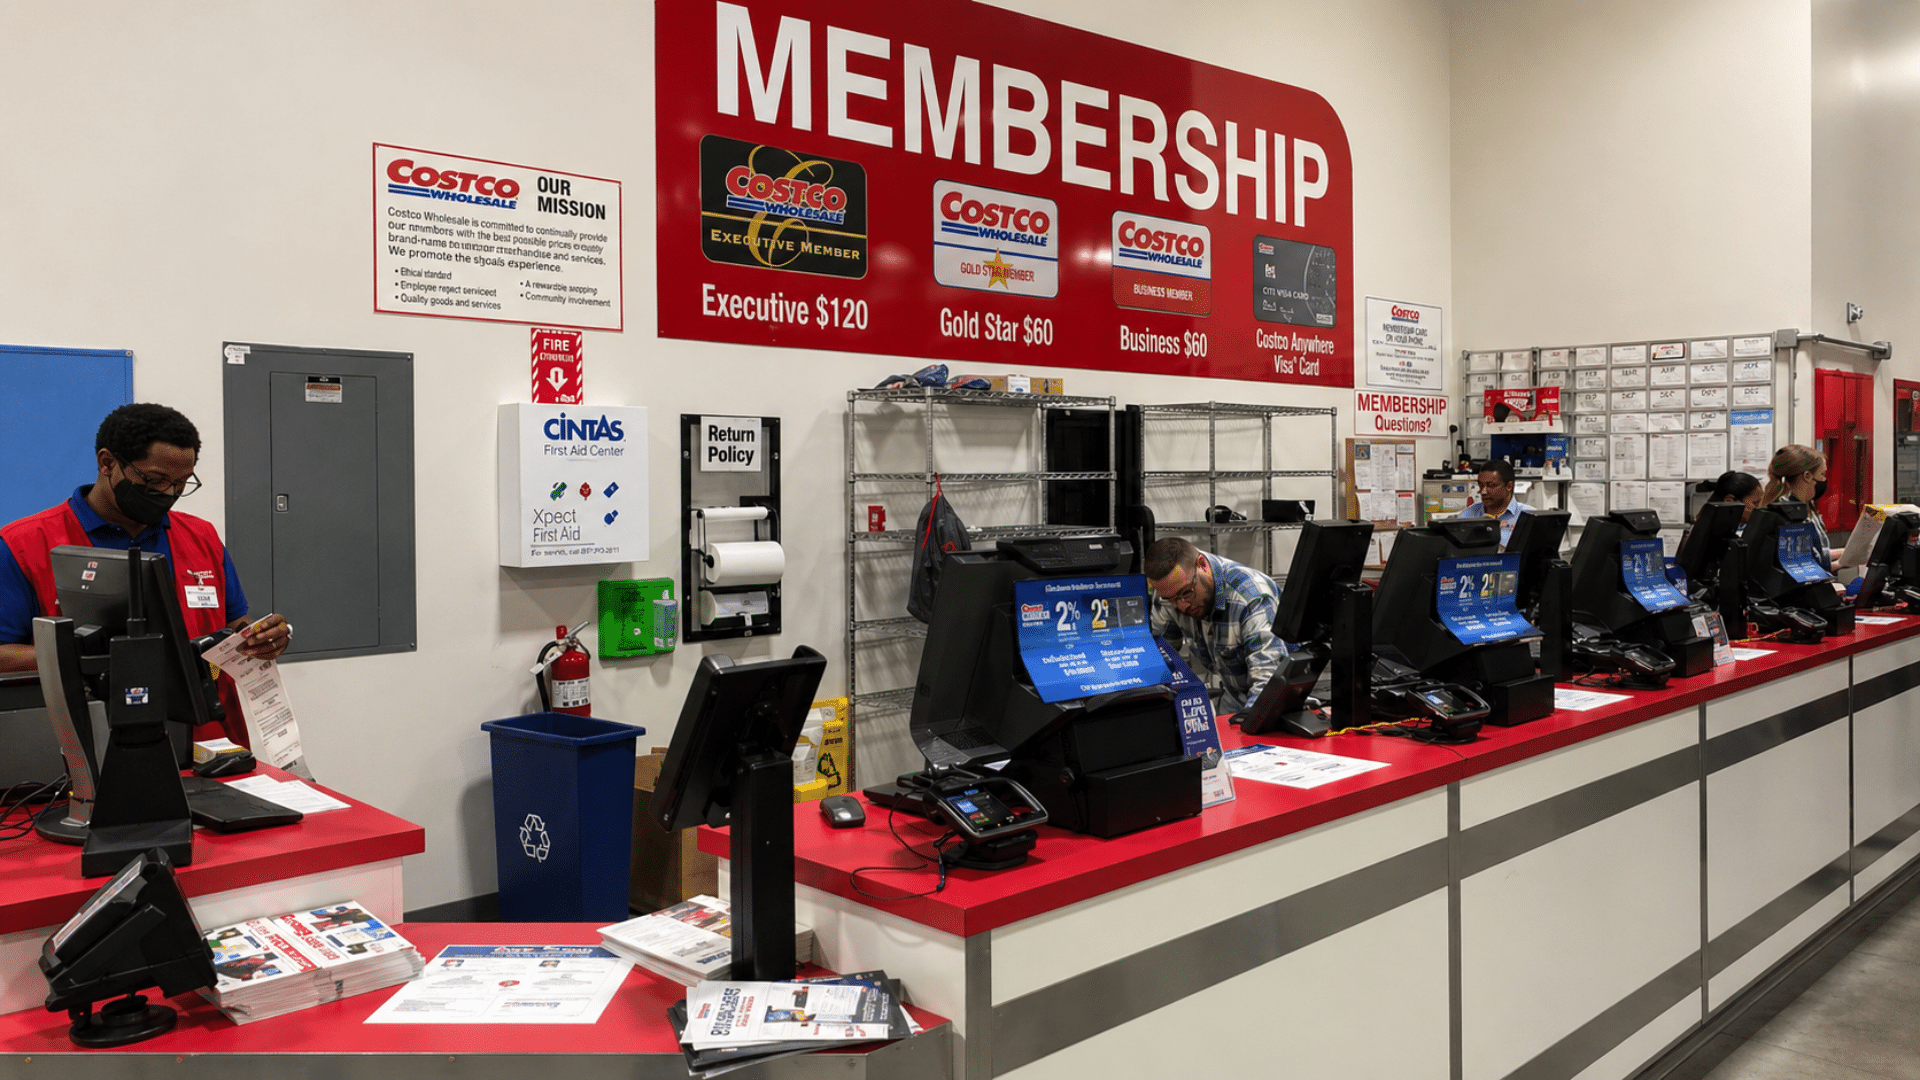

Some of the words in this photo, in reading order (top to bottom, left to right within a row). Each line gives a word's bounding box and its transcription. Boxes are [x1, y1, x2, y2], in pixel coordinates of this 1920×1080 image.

[716, 1, 1329, 227] MEMBERSHIP
[387, 158, 520, 198] COSTCO
[537, 176, 571, 197] OUR
[726, 165, 847, 211] COSTCO
[430, 189, 518, 210] WHOLESALE
[537, 196, 606, 220] MISSION
[388, 206, 422, 220] Costco
[424, 211, 470, 227] Wholesale
[471, 217, 479, 227] is
[526, 224, 534, 234] to
[941, 191, 1050, 234] COSTCO
[388, 221, 406, 230] our
[477, 231, 491, 241] the
[978, 227, 1048, 247] WHOLESALE
[1118, 220, 1204, 257] COSTCO
[388, 245, 406, 256] We
[409, 249, 453, 262] promote
[455, 253, 471, 263] the
[960, 262, 981, 276] GOLD
[525, 280, 531, 288] A
[455, 299, 470, 307] and
[702, 283, 809, 326] Executive
[816, 294, 869, 330] $120
[940, 307, 979, 339] Gold
[985, 312, 1019, 342] Star
[1023, 315, 1053, 347] $60
[543, 338, 570, 351] FIRE
[1120, 325, 1180, 355] Business
[1184, 329, 1207, 358] $60
[1256, 328, 1288, 350] Costco
[1291, 332, 1334, 355] Anywhere
[1299, 356, 1319, 376] Card
[1357, 393, 1447, 415] MEMBERSHIP
[708, 425, 755, 442] Return
[1375, 414, 1432, 433] Questions?
[570, 444, 587, 456] Aid
[590, 445, 625, 456] Center
[708, 445, 755, 466] Policy
[533, 508, 577, 527] Xpect
[533, 527, 557, 542] First
[560, 525, 580, 541] Aid
